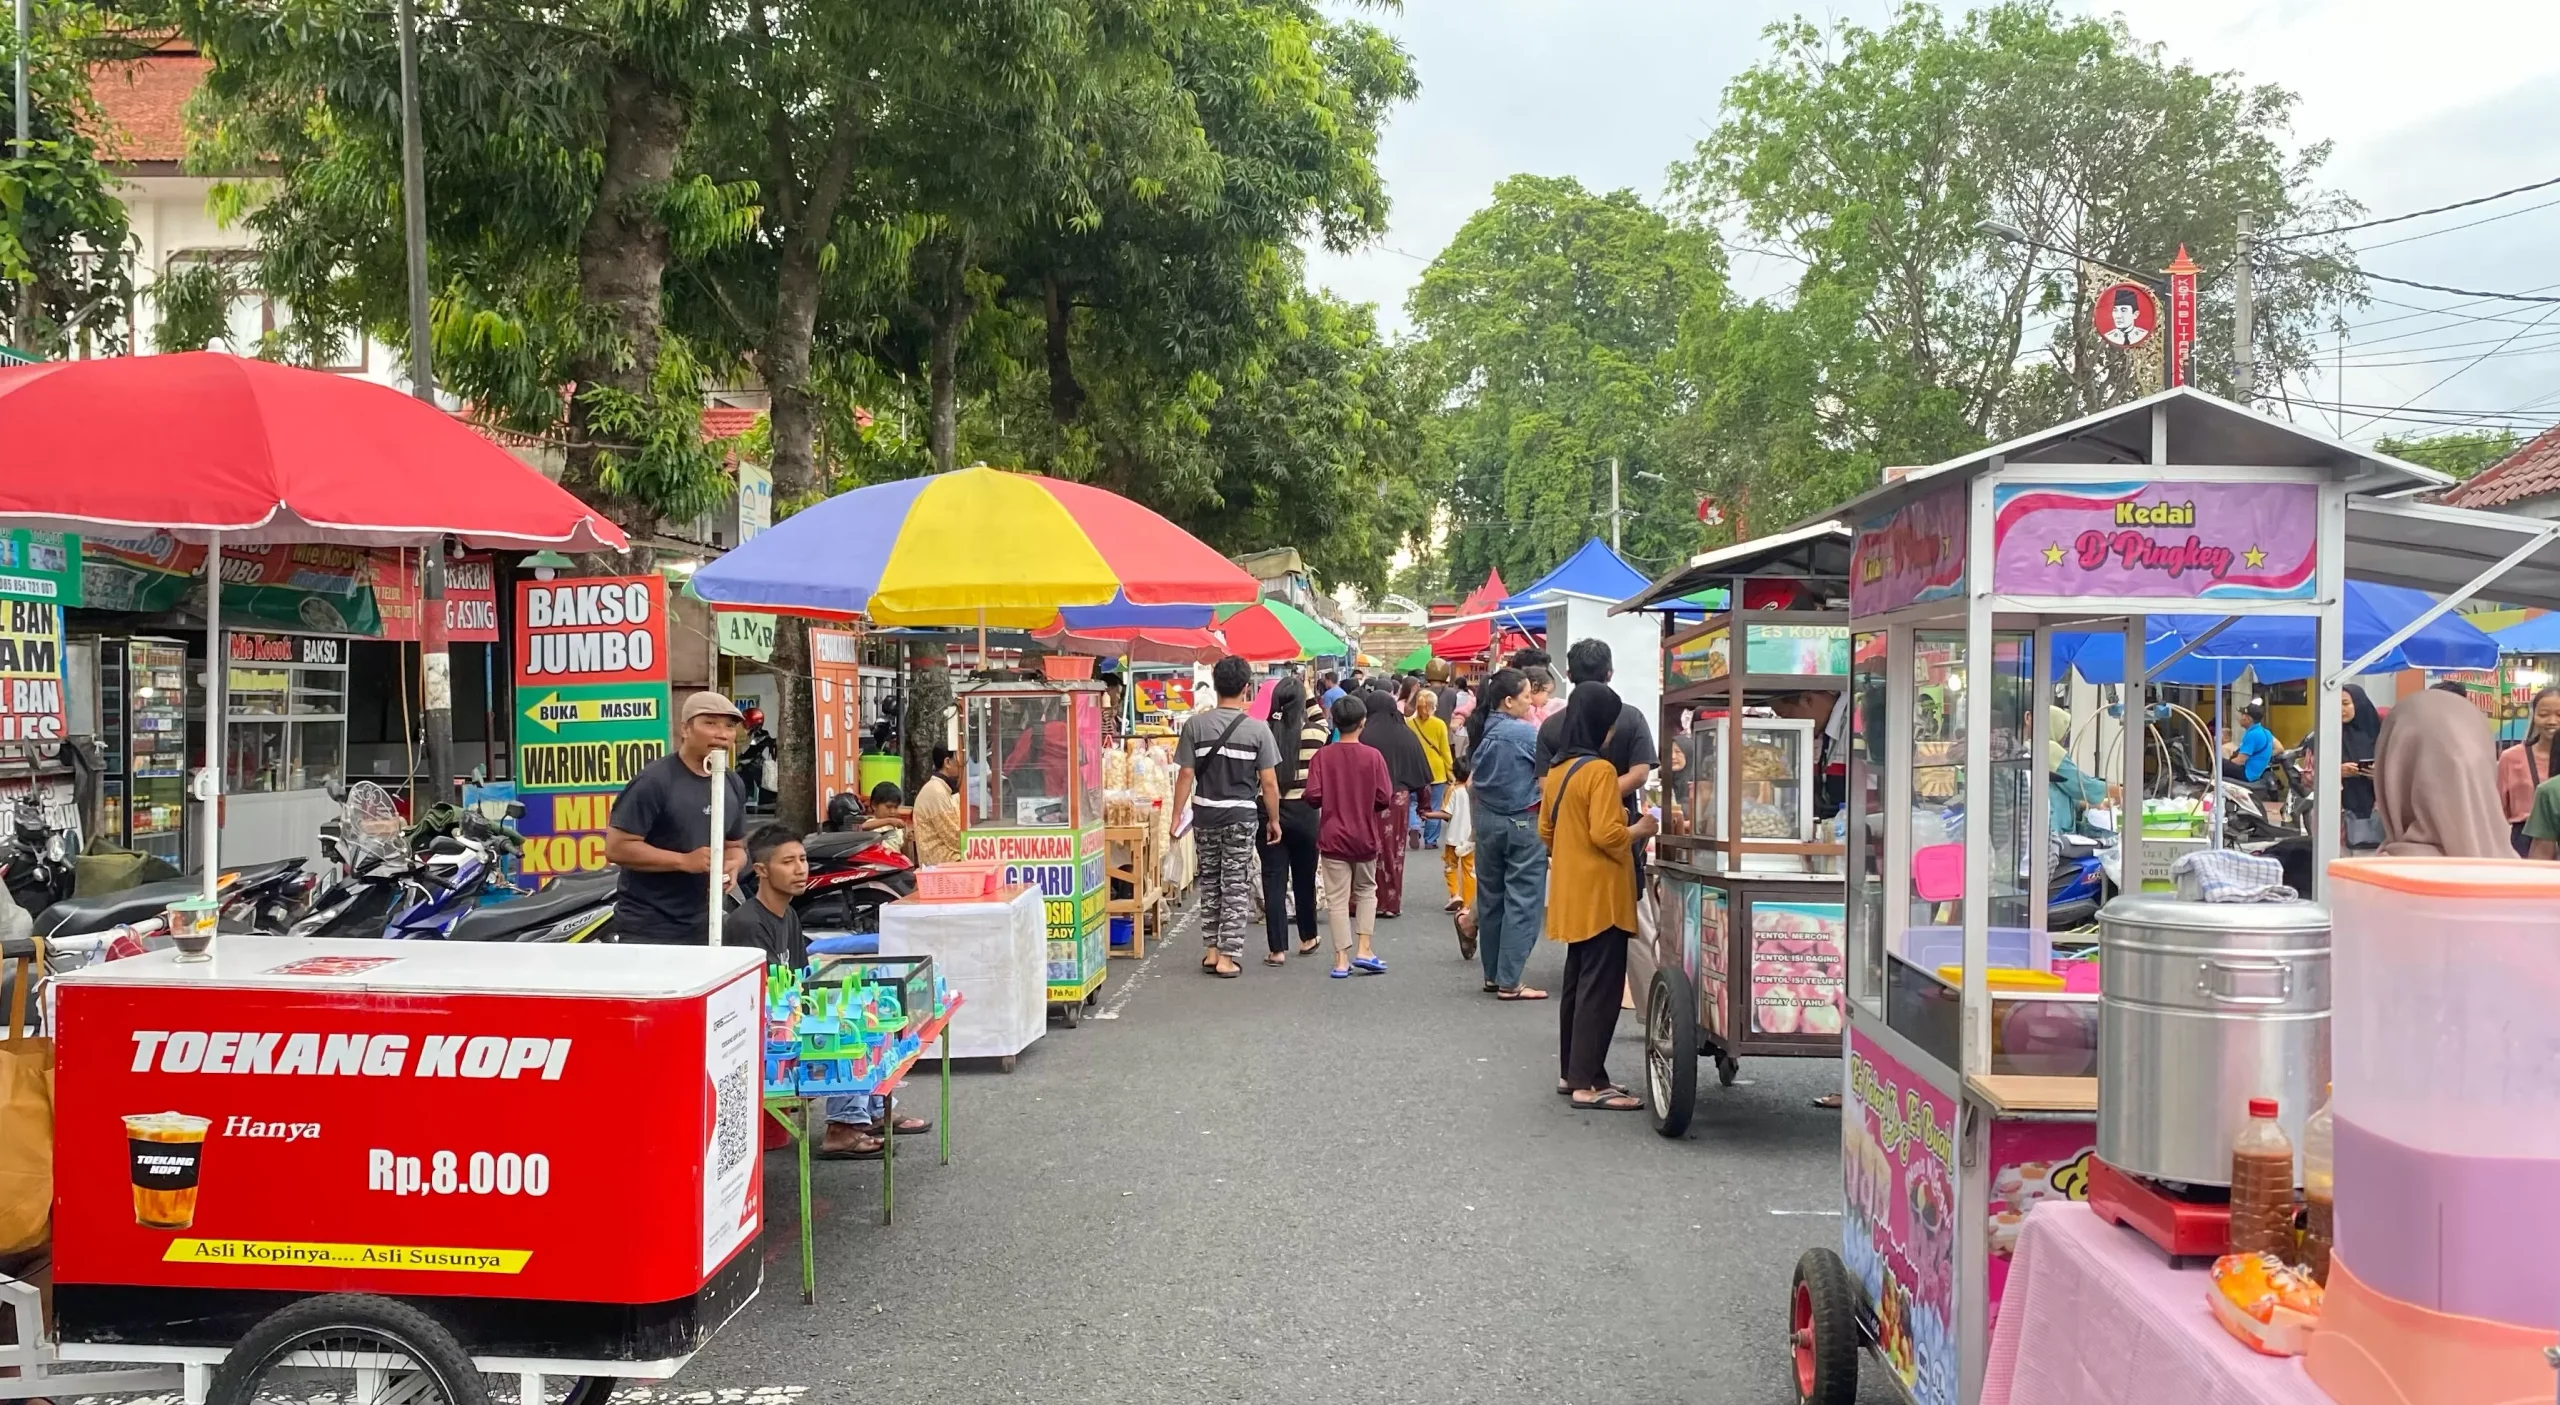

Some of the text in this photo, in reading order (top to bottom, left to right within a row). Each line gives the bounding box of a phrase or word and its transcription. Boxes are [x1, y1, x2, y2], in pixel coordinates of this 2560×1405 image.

[2114, 501, 2196, 526] Kedai
[2075, 530, 2234, 579] D'Pingkey
[191, 556, 265, 584] JMBO
[14, 579, 26, 592] 854
[12, 601, 53, 635] BAN
[456, 600, 495, 630] ASING
[527, 583, 650, 628] BAKSO
[1760, 626, 1783, 639] ES
[231, 633, 338, 664] Mie Kocok BAKSO
[526, 629, 654, 675] JUMBO
[13, 679, 59, 714] BAN
[540, 701, 652, 720] BUKA MASUK
[844, 678, 855, 795] ASIN
[523, 745, 610, 785] WARUNG
[967, 838, 996, 860] JASA
[999, 837, 1073, 860] PENUKARAN
[1755, 932, 1830, 941] PENTOL MERCON
[1755, 954, 1790, 962] PENTOL
[1805, 955, 1840, 963] DAGING
[1755, 976, 1790, 984] PENTOL
[1755, 998, 1790, 1006] SIOMAY
[1800, 999, 1826, 1007] TAHU
[131, 1030, 573, 1081] TOEKANG KOPI
[222, 1115, 321, 1143] Hanya
[137, 1155, 195, 1166] TOEKANG
[149, 1165, 182, 1175] KOPI
[368, 1148, 550, 1197] Rp,8.000
[195, 1242, 235, 1257] Asli
[361, 1247, 402, 1264] Asli
[409, 1249, 500, 1269] Susunya
